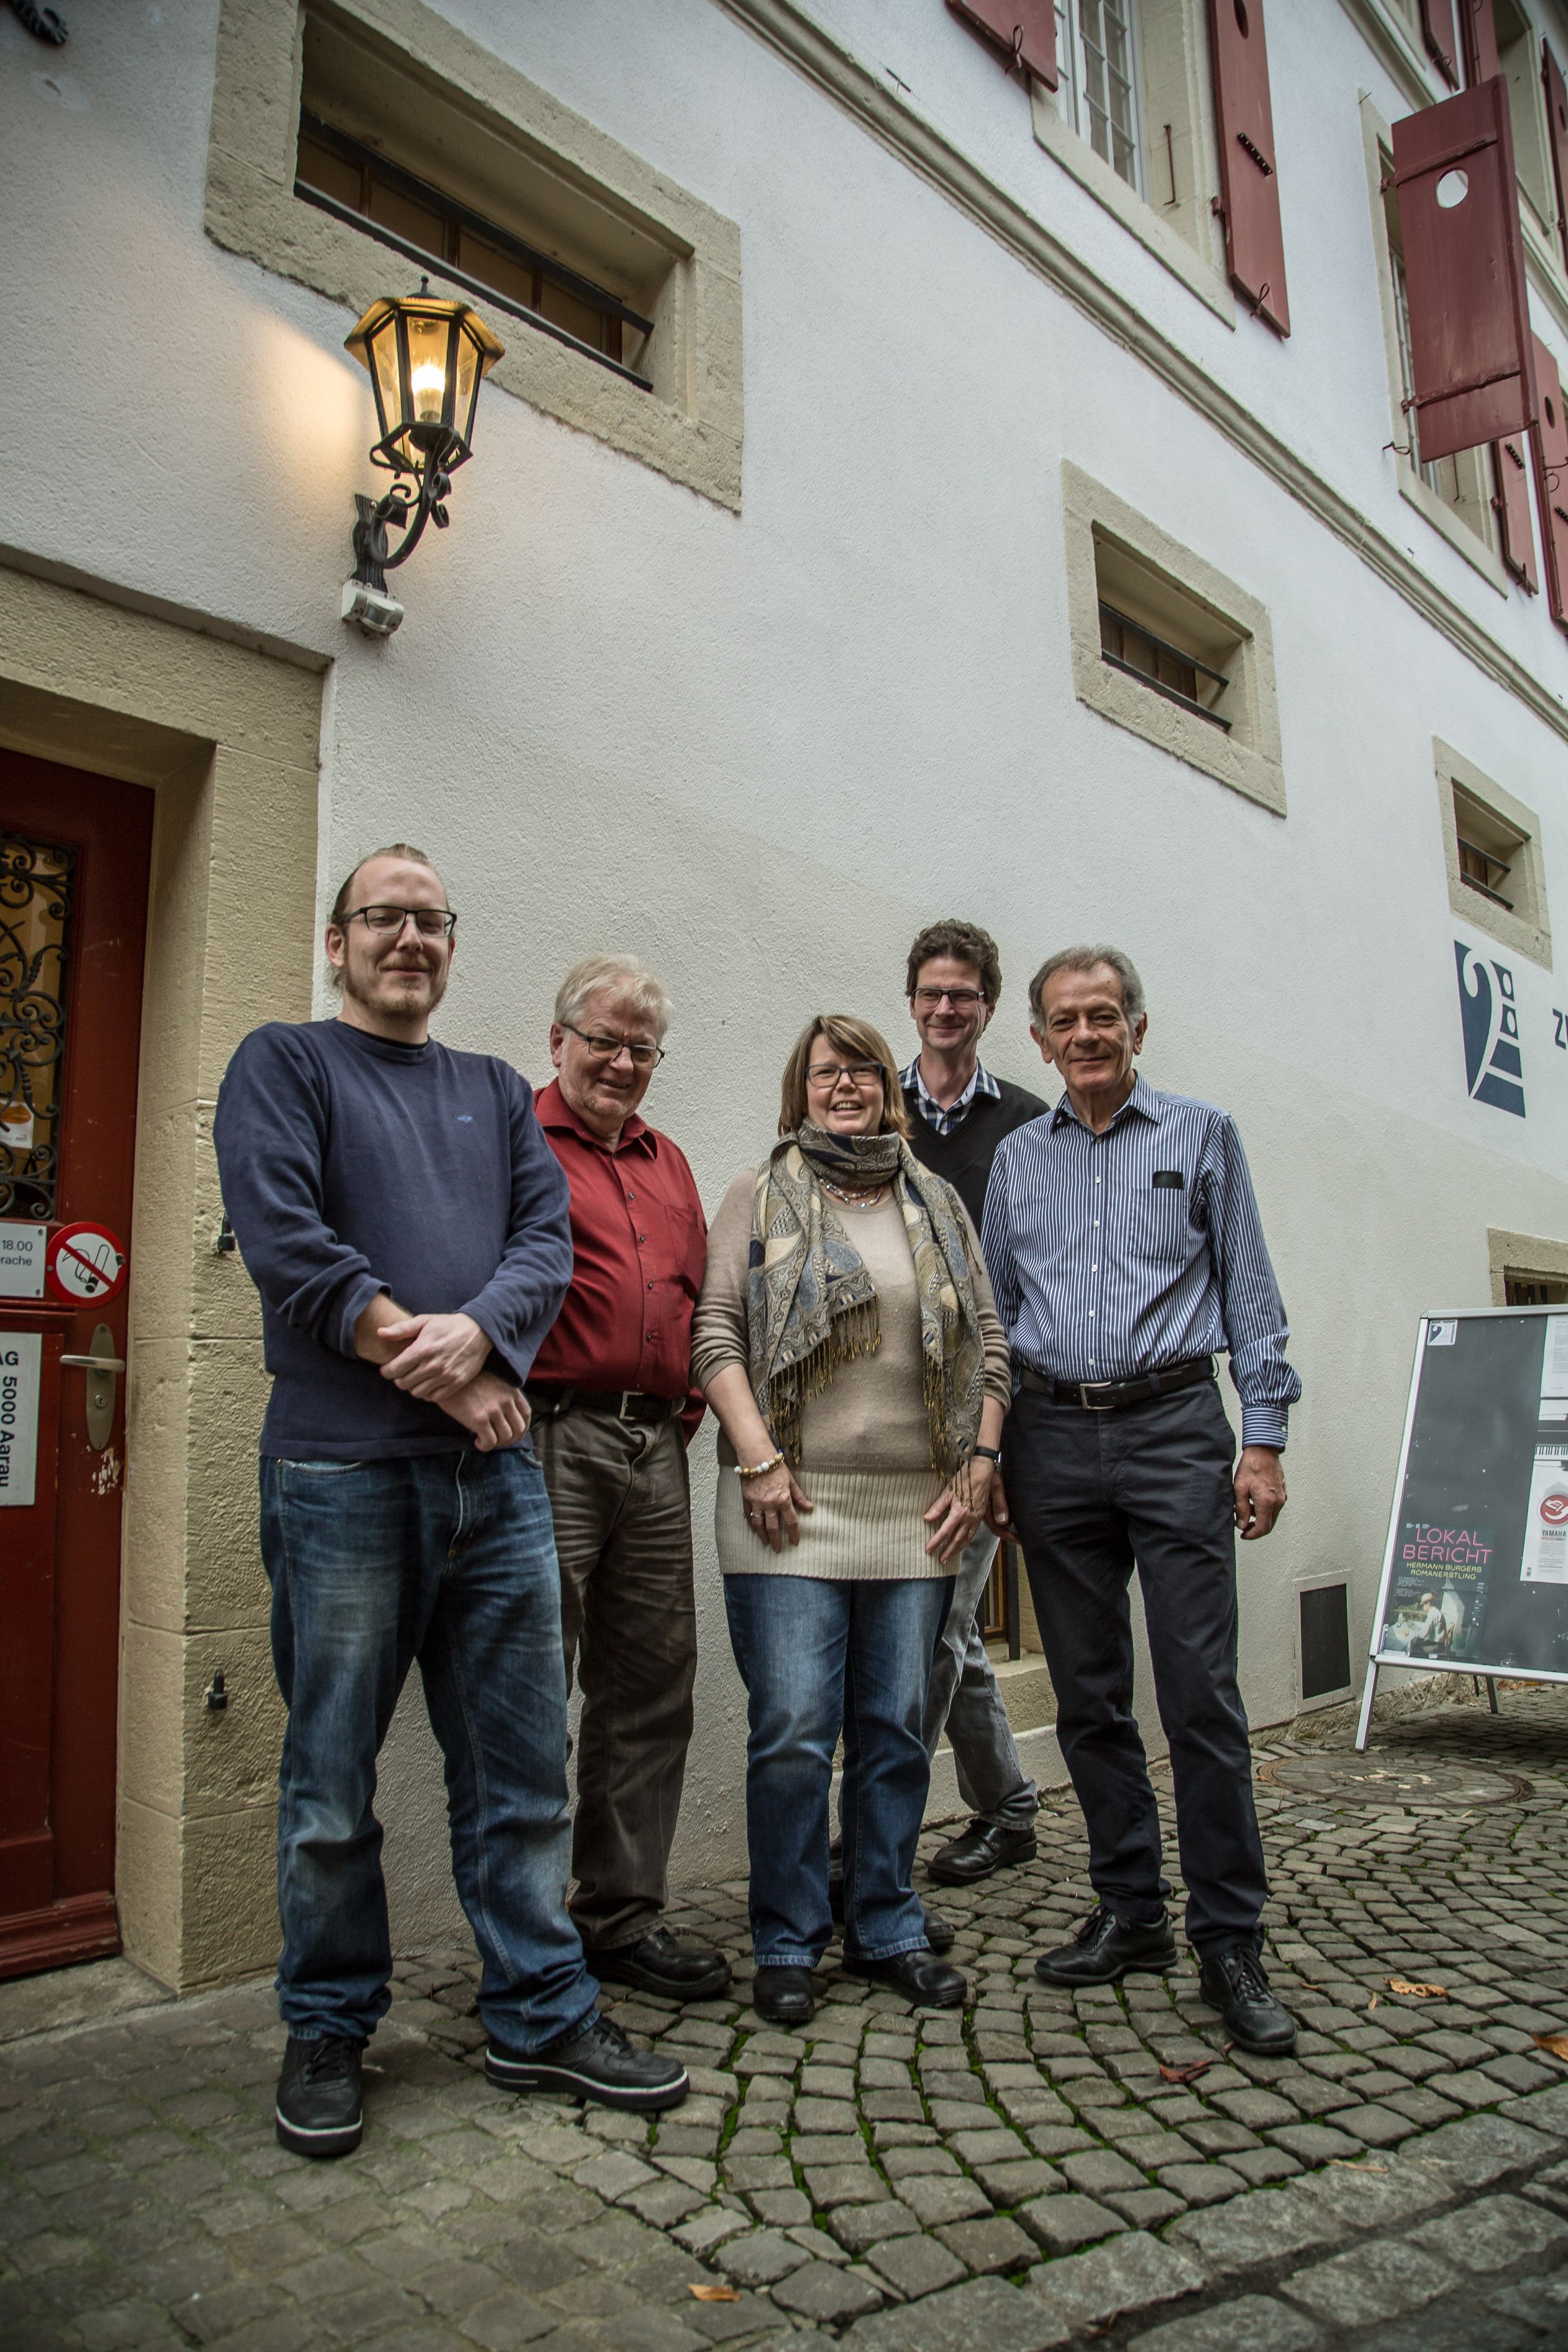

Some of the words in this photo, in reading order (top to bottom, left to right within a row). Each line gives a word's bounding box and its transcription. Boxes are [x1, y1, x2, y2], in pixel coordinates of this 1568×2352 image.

[1552, 1007, 1568, 1050] z
[2, 1239, 33, 1252] 18.00
[0, 1255, 32, 1266] rache
[0, 1350, 19, 1366] G
[1, 1375, 17, 1425] 5000
[0, 1429, 15, 1487] Aarau
[1416, 1526, 1484, 1546] LOKAL
[1541, 1529, 1566, 1538] YAMAHA
[1403, 1544, 1493, 1564] BERICHT
[1406, 1561, 1444, 1570] HERMANN
[1445, 1564, 1482, 1573] BURGERS
[1410, 1569, 1477, 1580] ROMANERSTLING
